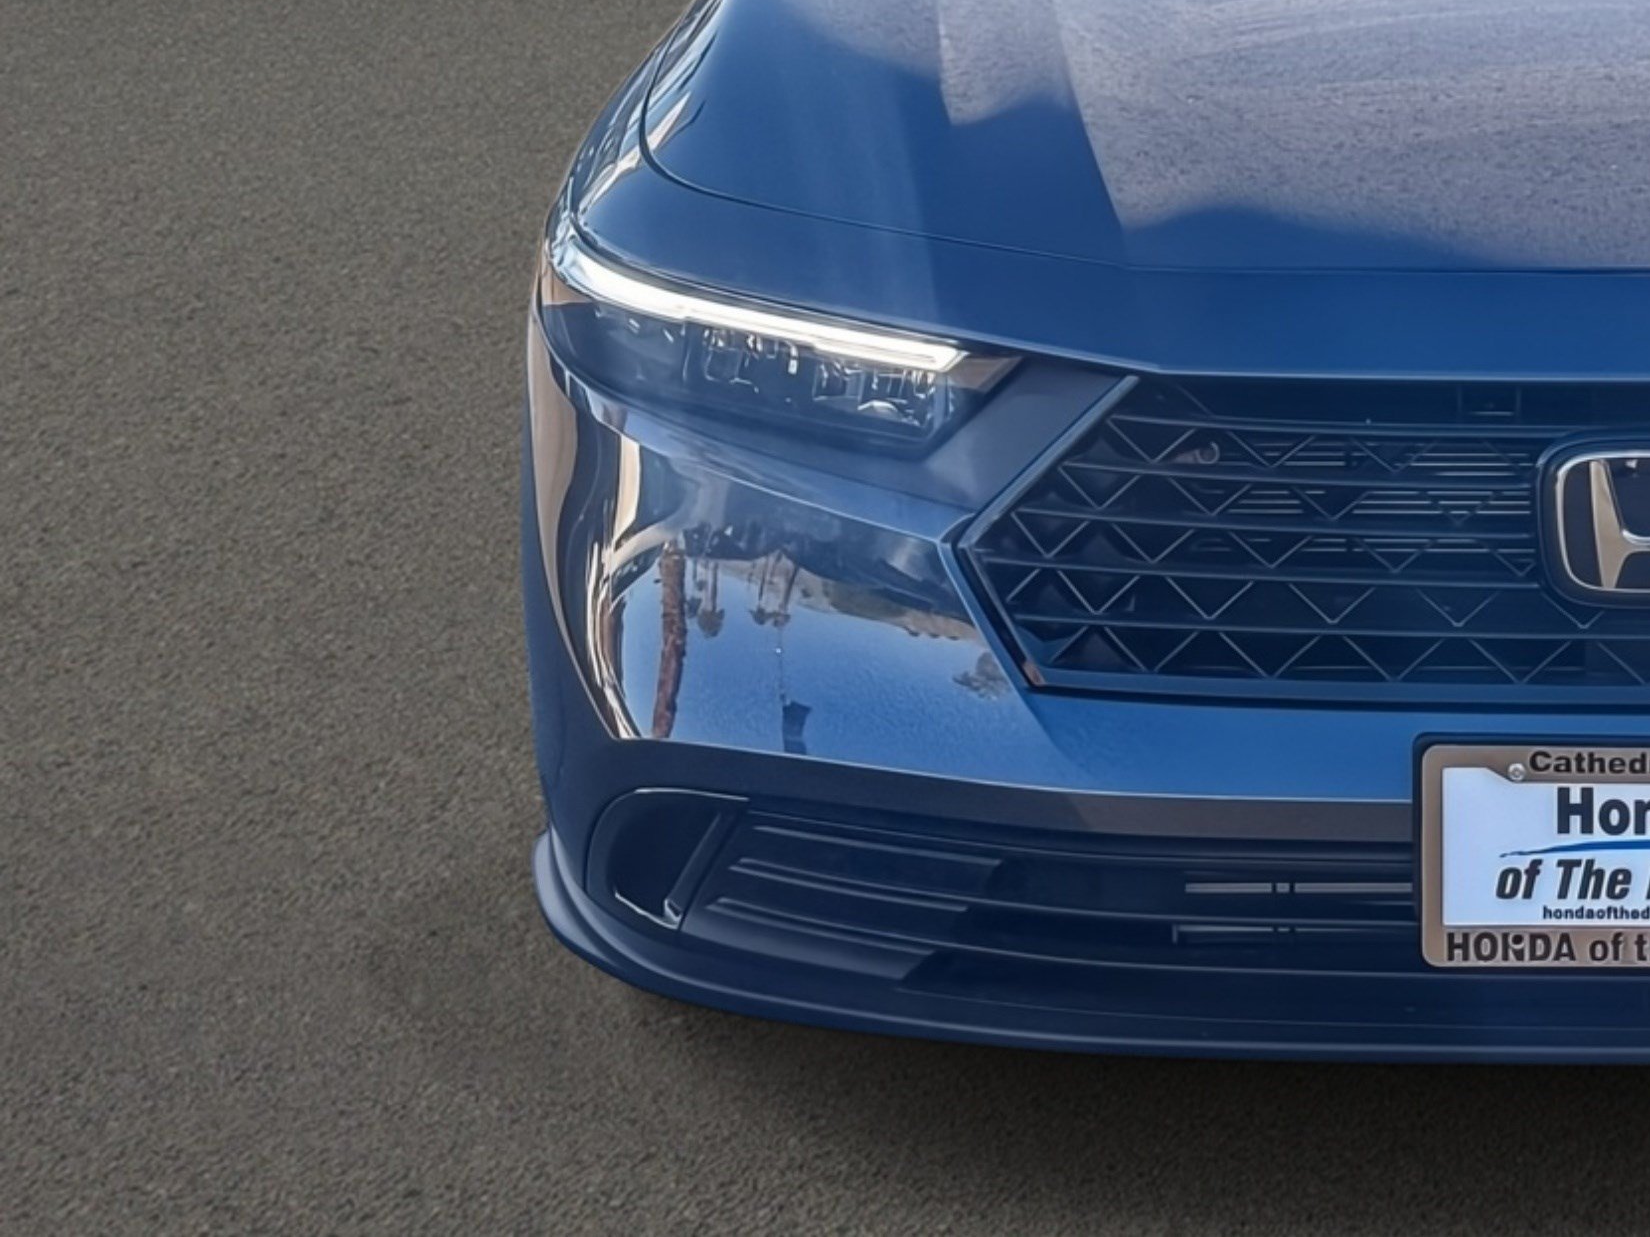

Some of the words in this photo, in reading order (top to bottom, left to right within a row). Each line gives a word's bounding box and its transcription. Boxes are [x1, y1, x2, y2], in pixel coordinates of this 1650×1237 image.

[1495, 859, 1542, 901] of
[1555, 858, 1632, 901] The
[1446, 931, 1577, 962] HONDA
[1589, 931, 1624, 962] of
